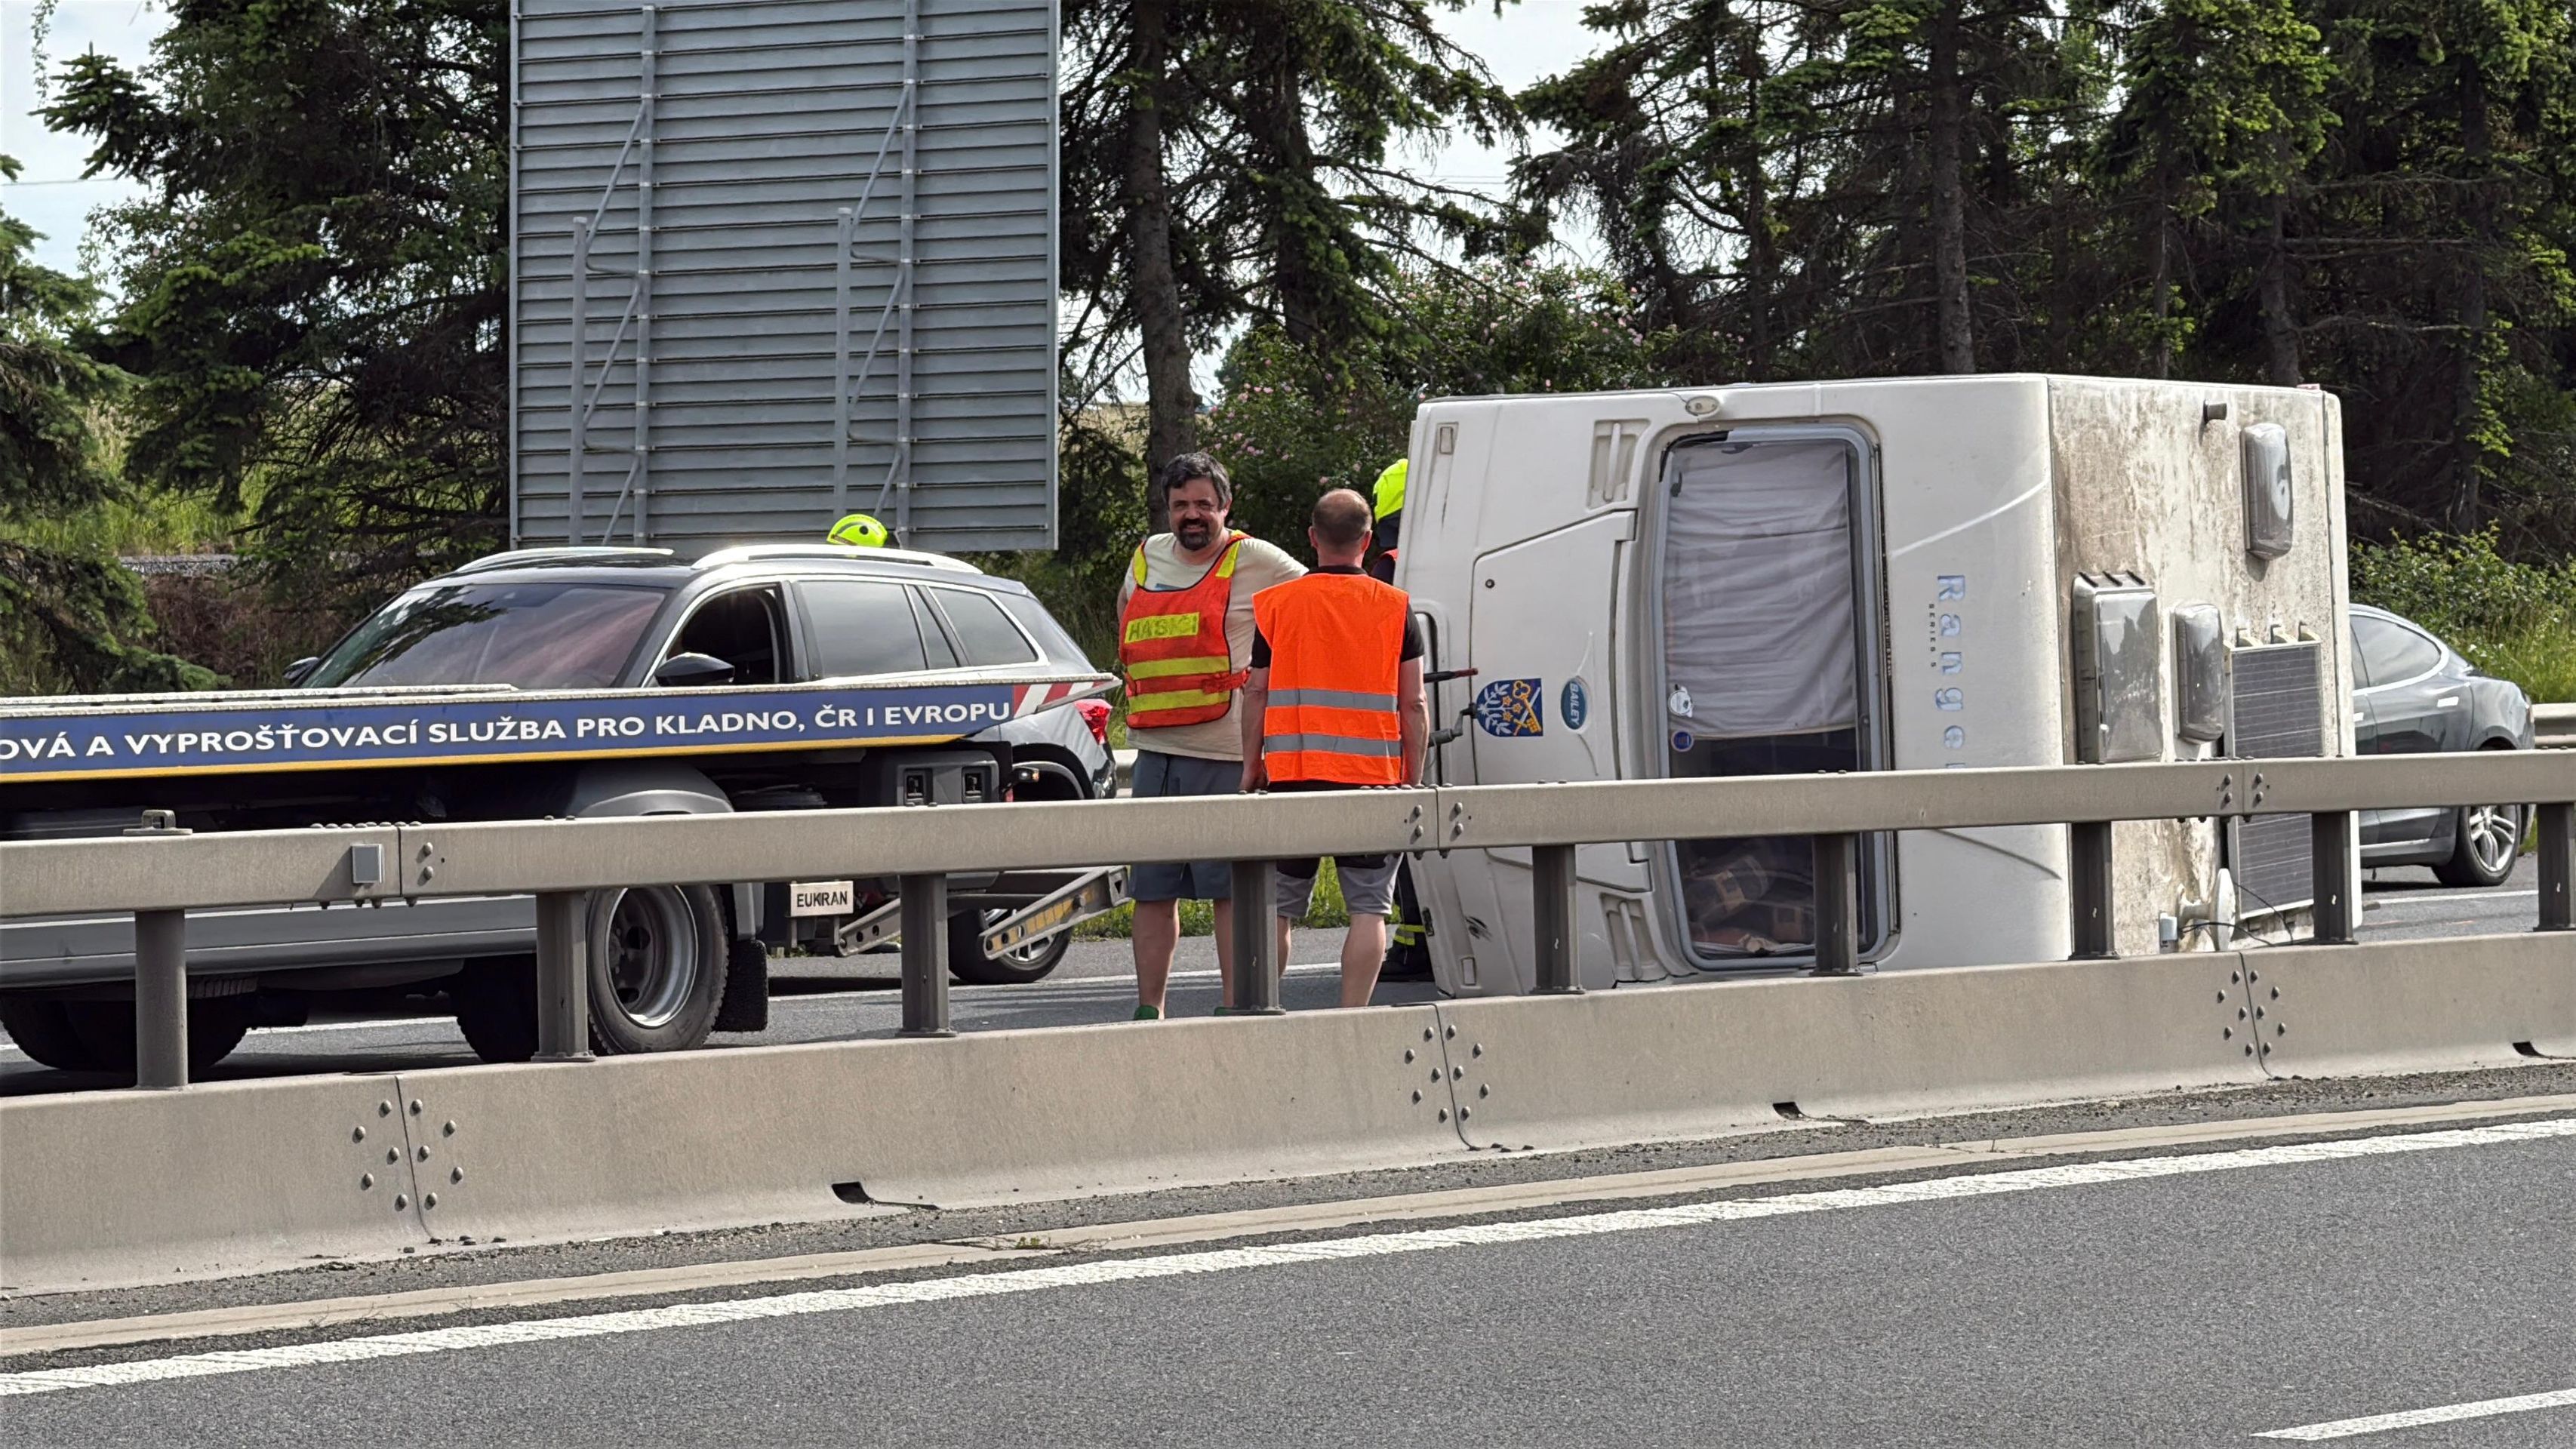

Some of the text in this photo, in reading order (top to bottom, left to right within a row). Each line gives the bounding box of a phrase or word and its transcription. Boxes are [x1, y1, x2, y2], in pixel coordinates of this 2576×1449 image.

[1928, 603, 1937, 652] SERIES
[1570, 683, 1580, 725] BAILEY
[85, 736, 115, 757] A
[125, 719, 419, 755] VYPROŠŤOVACÍ
[429, 715, 567, 743] SLUŽBA
[577, 716, 645, 738] PRO
[656, 710, 805, 735] KLADNO,
[815, 705, 858, 728] ČR
[866, 707, 874, 726] I
[885, 702, 1010, 725] EVROPU
[796, 891, 848, 908] EUKRAN
